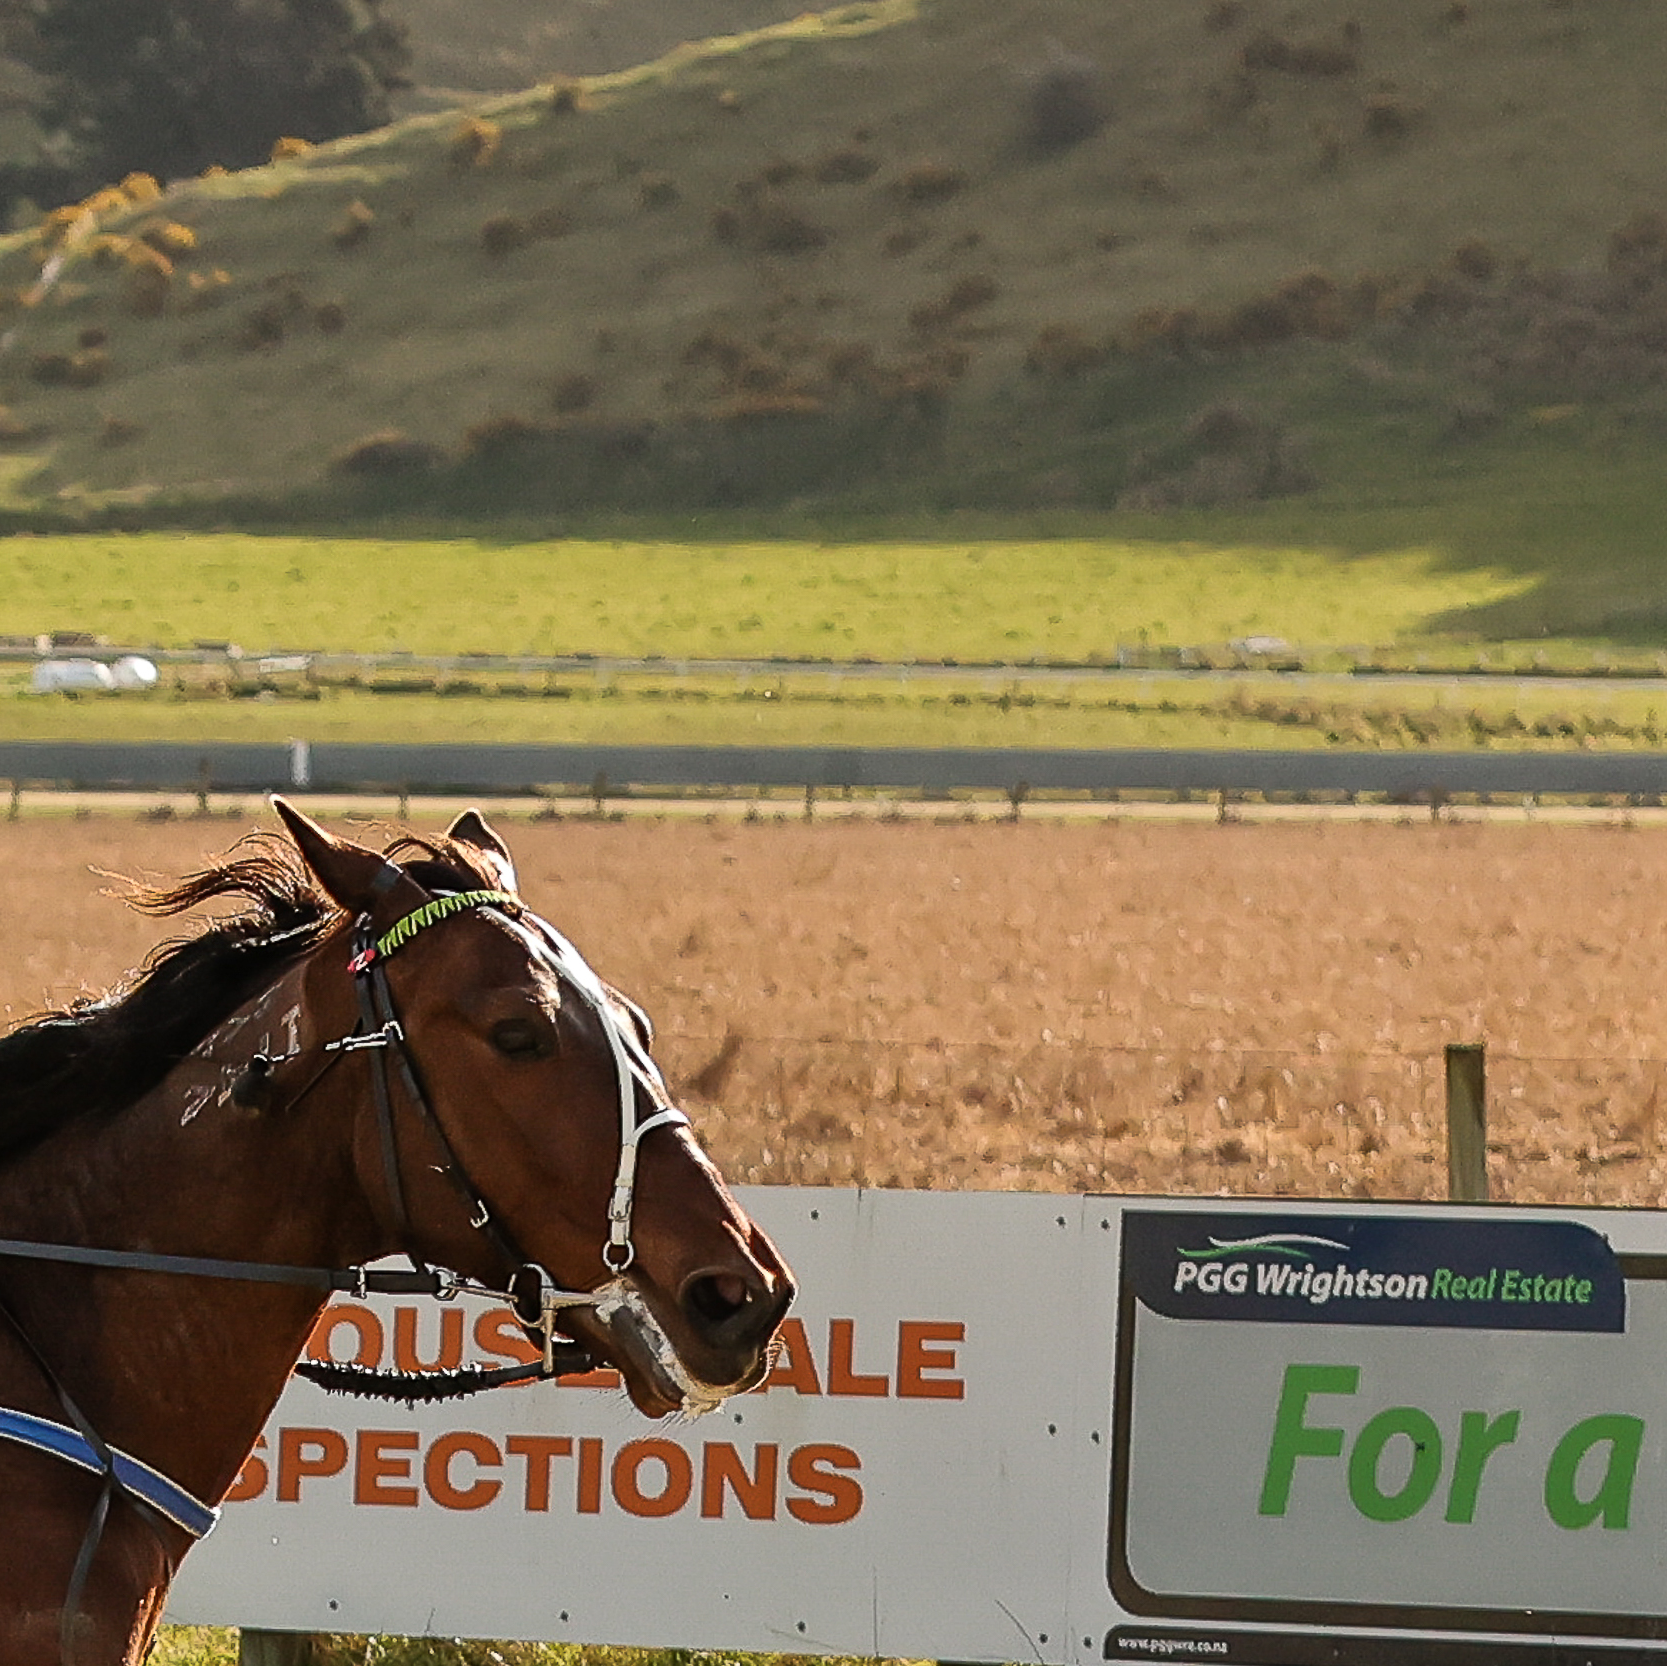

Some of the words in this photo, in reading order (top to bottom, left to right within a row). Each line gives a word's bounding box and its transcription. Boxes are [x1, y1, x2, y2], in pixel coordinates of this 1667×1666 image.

[1173, 1262, 1249, 1296] PGG
[1255, 1262, 1429, 1305] Wrightson
[1430, 1268, 1496, 1301] Real
[1500, 1269, 1592, 1304] Estate
[748, 1317, 966, 1399] ALE
[1258, 1363, 1523, 1524] For
[1544, 1412, 1646, 1531] a
